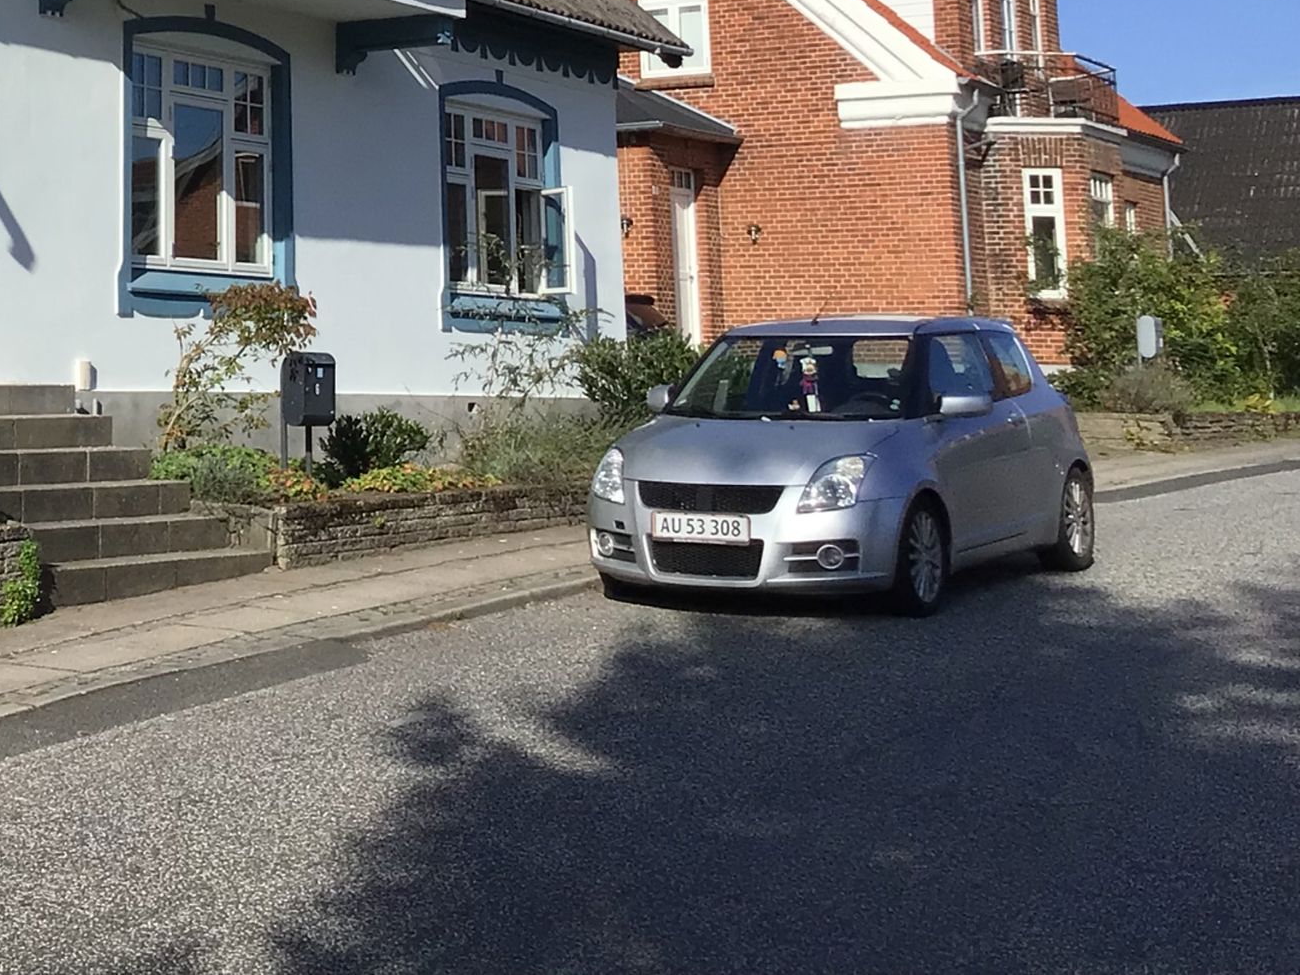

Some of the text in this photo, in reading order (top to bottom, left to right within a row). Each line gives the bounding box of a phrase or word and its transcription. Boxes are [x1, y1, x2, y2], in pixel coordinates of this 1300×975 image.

[660, 517, 741, 537] AU 53 308
